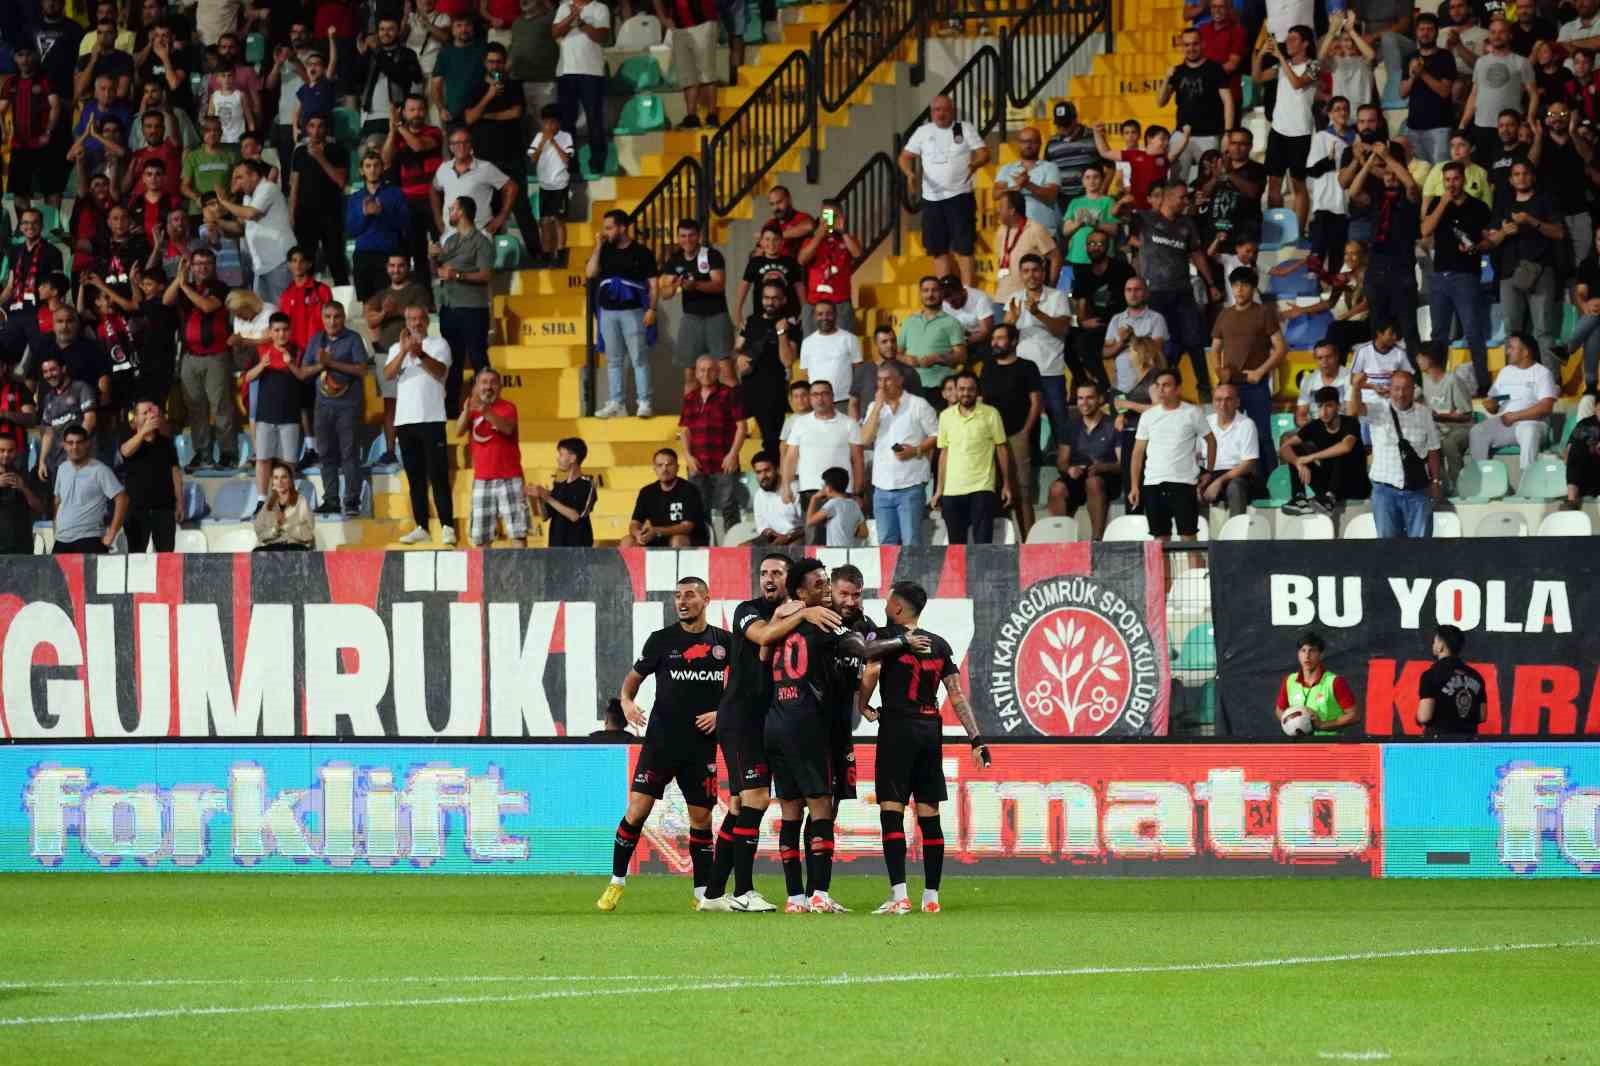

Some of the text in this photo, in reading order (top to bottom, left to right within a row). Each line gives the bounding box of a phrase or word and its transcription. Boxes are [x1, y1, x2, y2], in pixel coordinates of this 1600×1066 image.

[541, 321, 576, 336] SIRA
[993, 577, 1099, 667] KARAGÜMRÜK
[1099, 591, 1144, 644] SPOR
[1270, 574, 1573, 633] BU YOLA
[669, 669, 725, 682] VAVACARS
[26, 763, 529, 859] forklift
